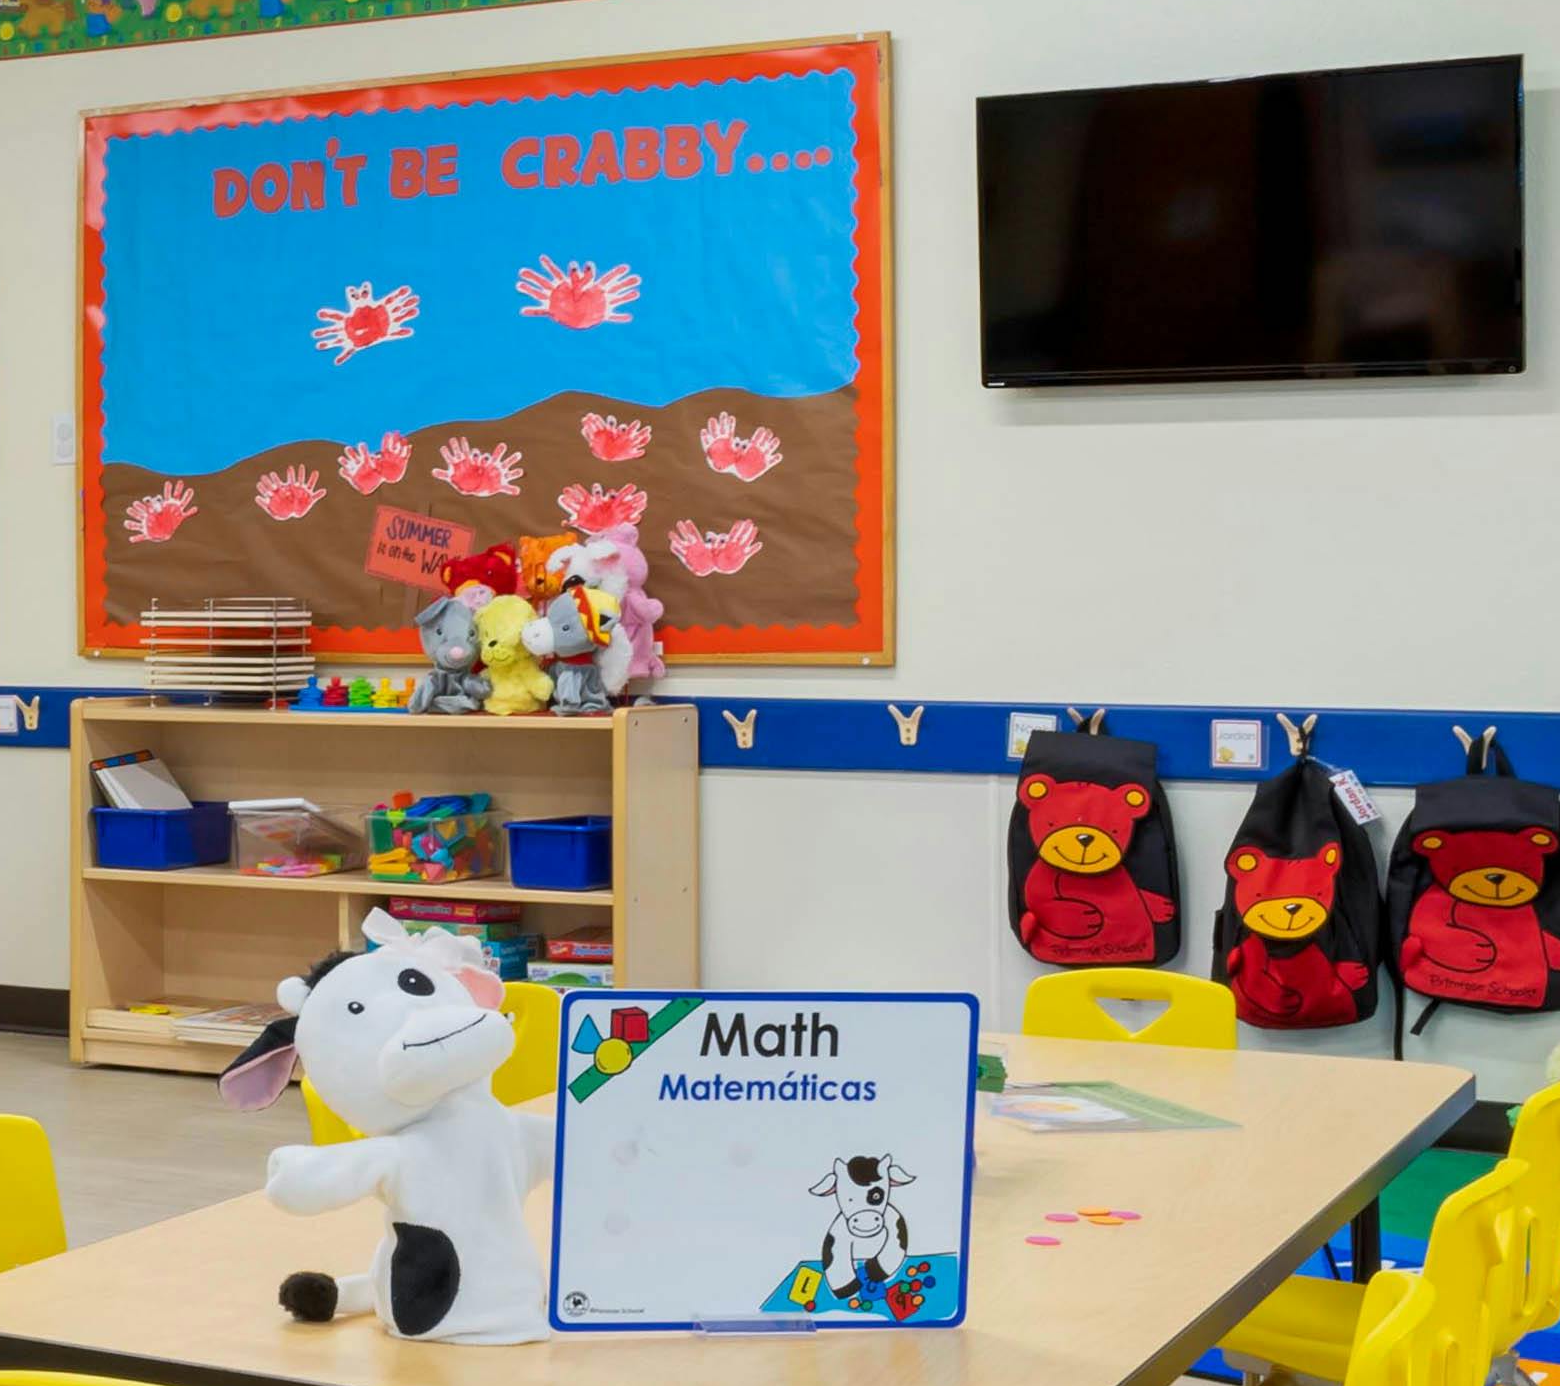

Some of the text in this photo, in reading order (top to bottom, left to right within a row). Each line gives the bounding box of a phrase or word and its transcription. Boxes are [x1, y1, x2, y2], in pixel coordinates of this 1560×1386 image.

[212, 137, 368, 220] DON'T
[389, 142, 460, 201] BE
[385, 514, 453, 549] SUMMER
[1216, 729, 1257, 742] Jordan
[1345, 787, 1371, 821] Jordan
[1427, 973, 1487, 993] Primrose
[699, 1011, 840, 1058] Math
[658, 1070, 878, 1102] Matemáticas
